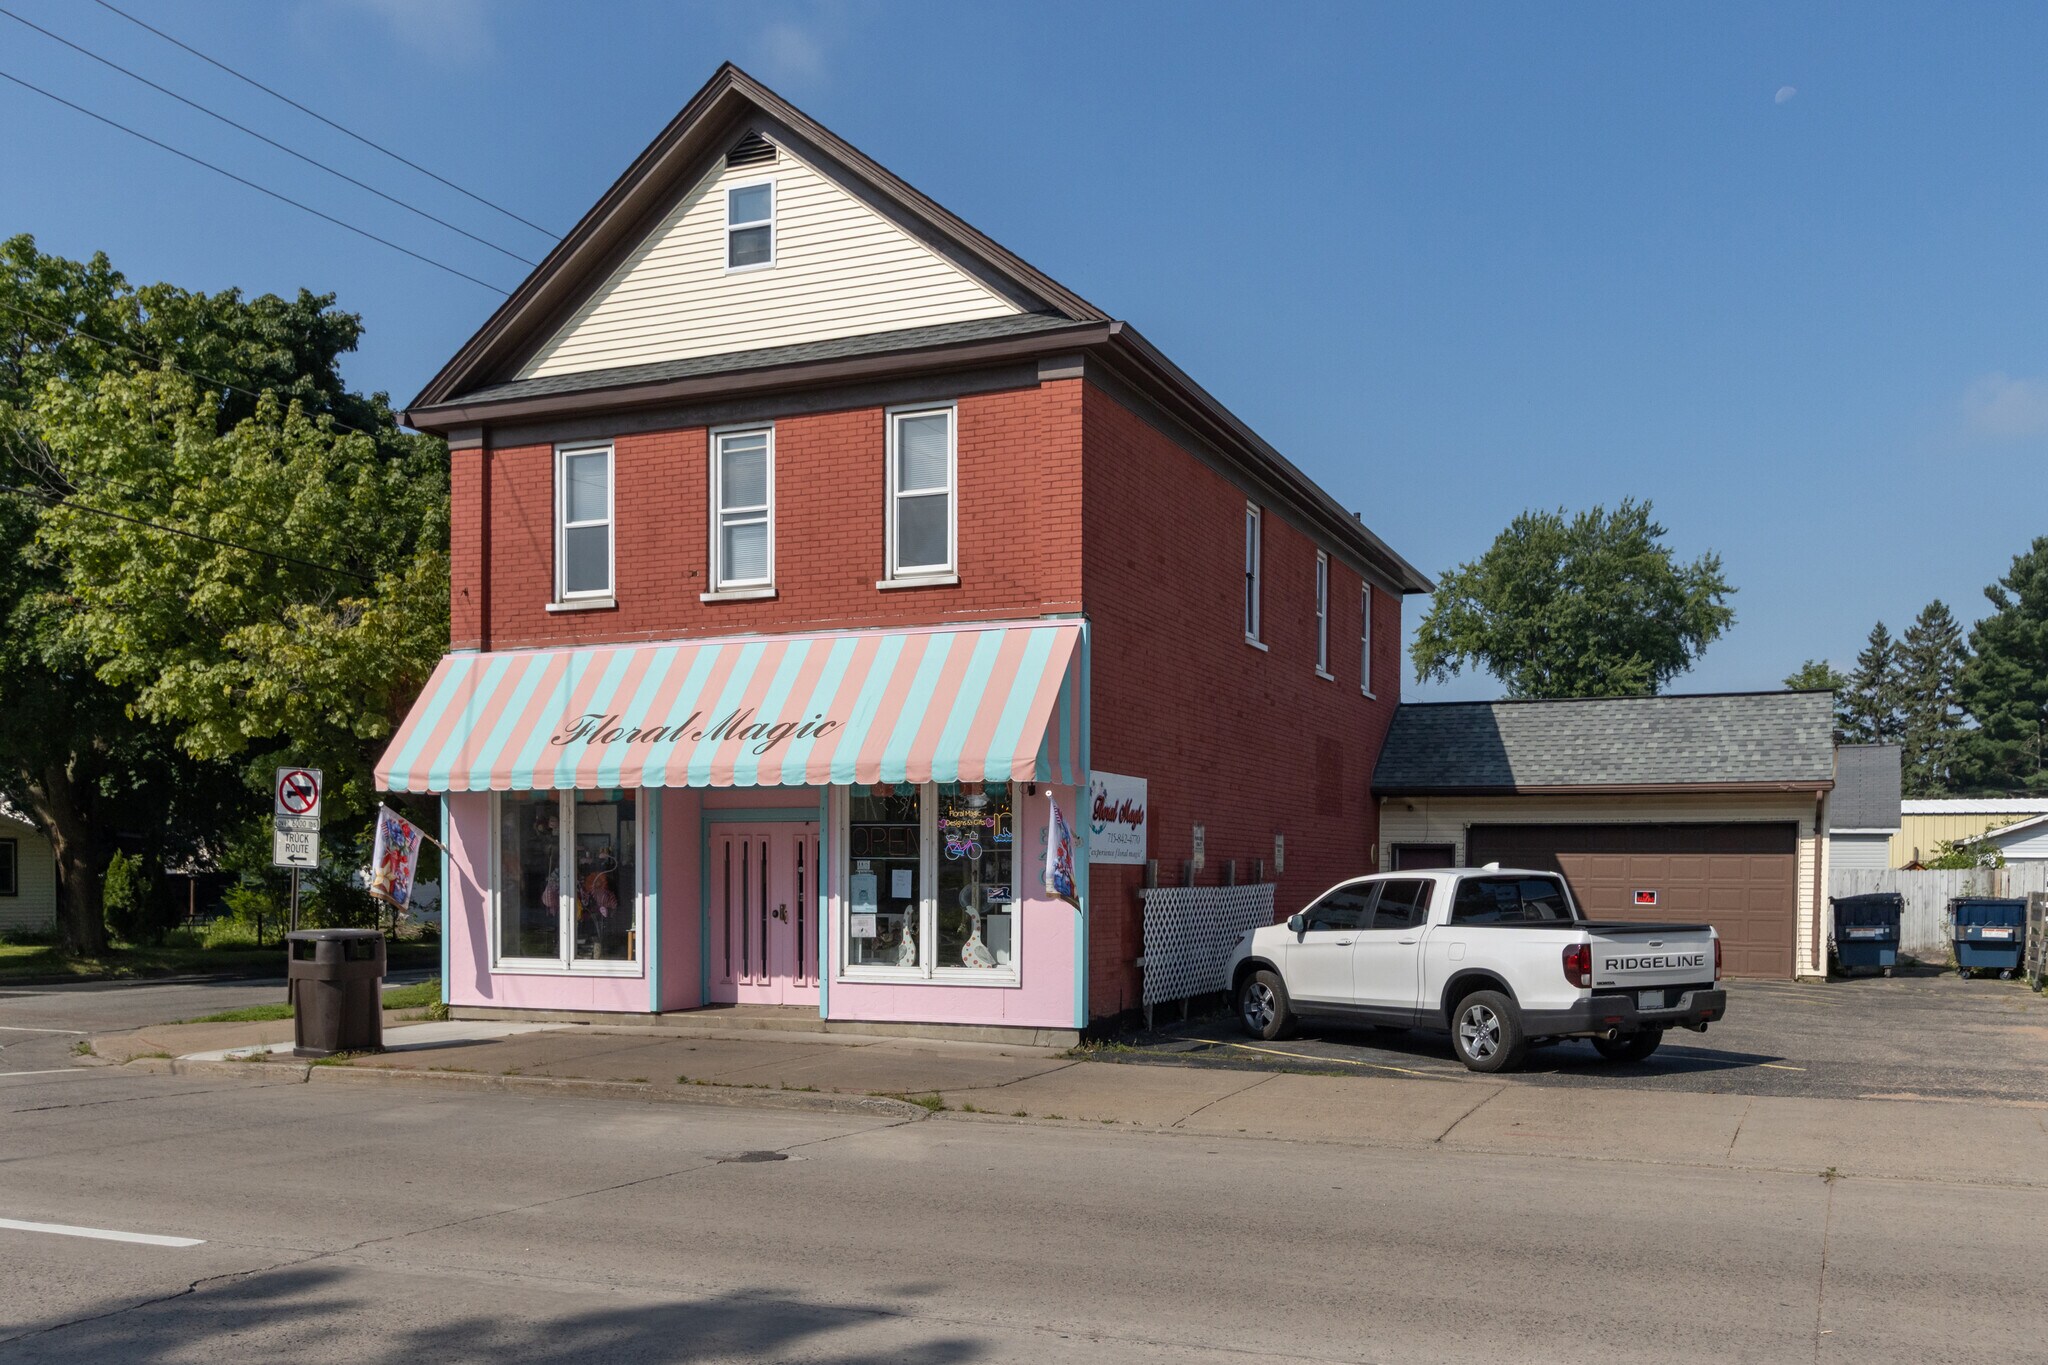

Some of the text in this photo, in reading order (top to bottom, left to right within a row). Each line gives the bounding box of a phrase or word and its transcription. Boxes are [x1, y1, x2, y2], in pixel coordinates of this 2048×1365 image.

[551, 707, 846, 756] Floral Magic
[1092, 793, 1144, 831] Floral Magic
[285, 844, 309, 853] ROUTE
[286, 833, 309, 843] TRUCK
[852, 827, 921, 856] OPEN
[1605, 955, 1705, 971] RIDGELINE
